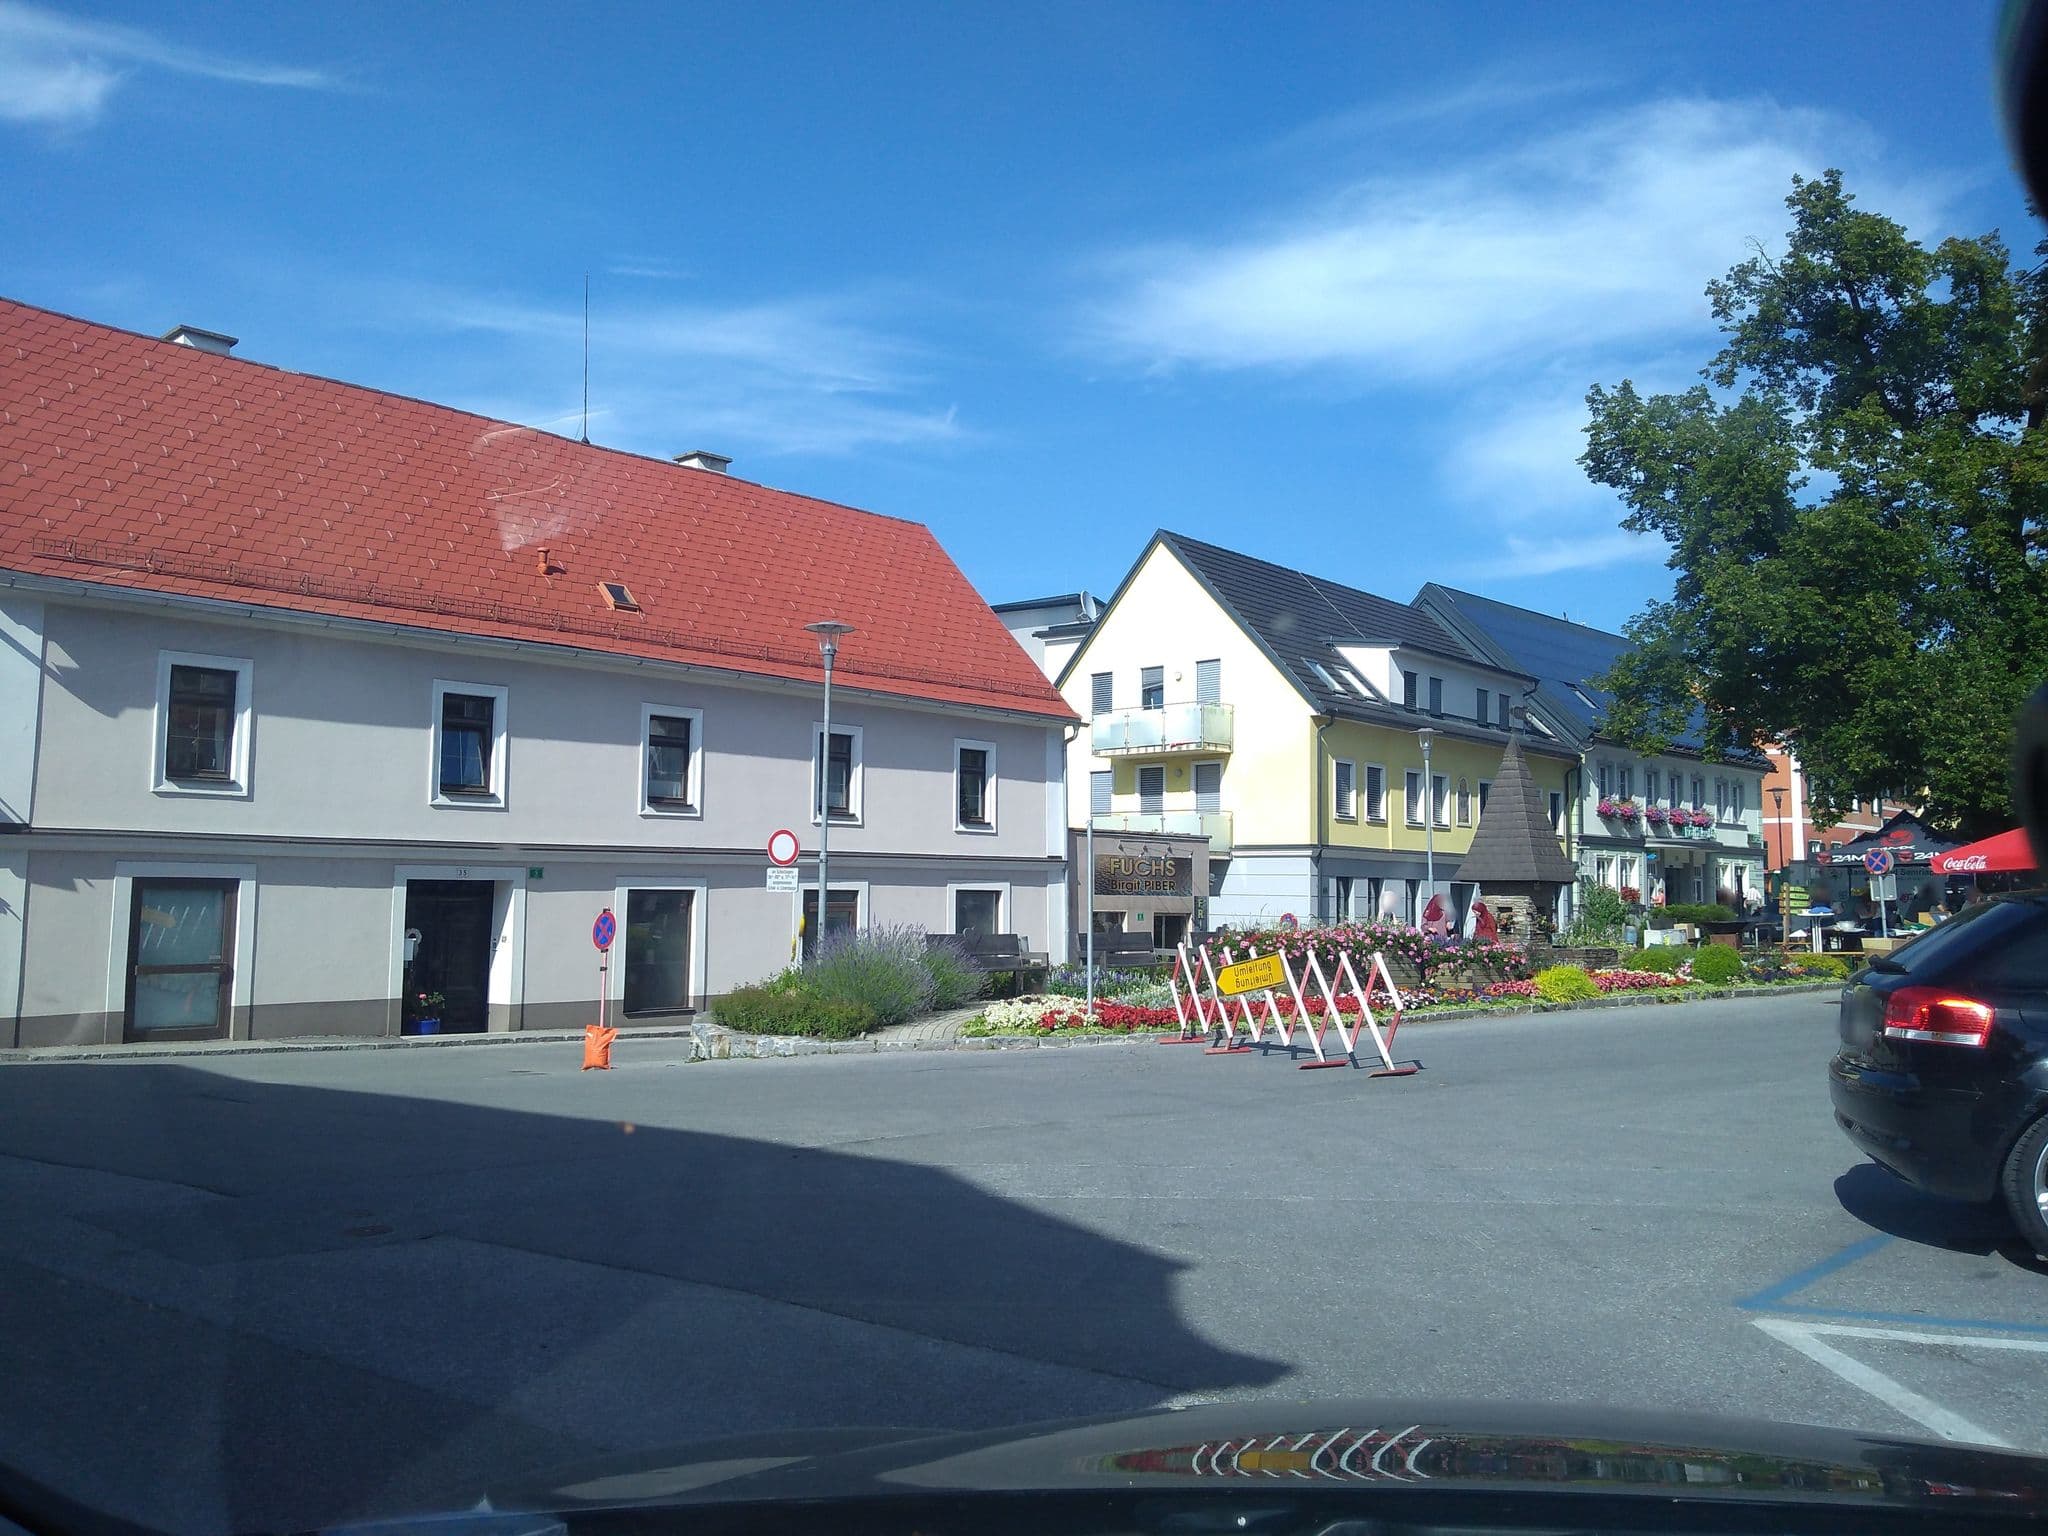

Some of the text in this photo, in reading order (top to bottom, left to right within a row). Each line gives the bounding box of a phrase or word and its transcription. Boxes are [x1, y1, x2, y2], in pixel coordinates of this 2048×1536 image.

[1110, 858, 1176, 877] FUCHS
[1943, 855, 1987, 871] Coca-Cola
[1111, 880, 1176, 892] Birgit PIBER
[1234, 961, 1271, 977] Umleitung
